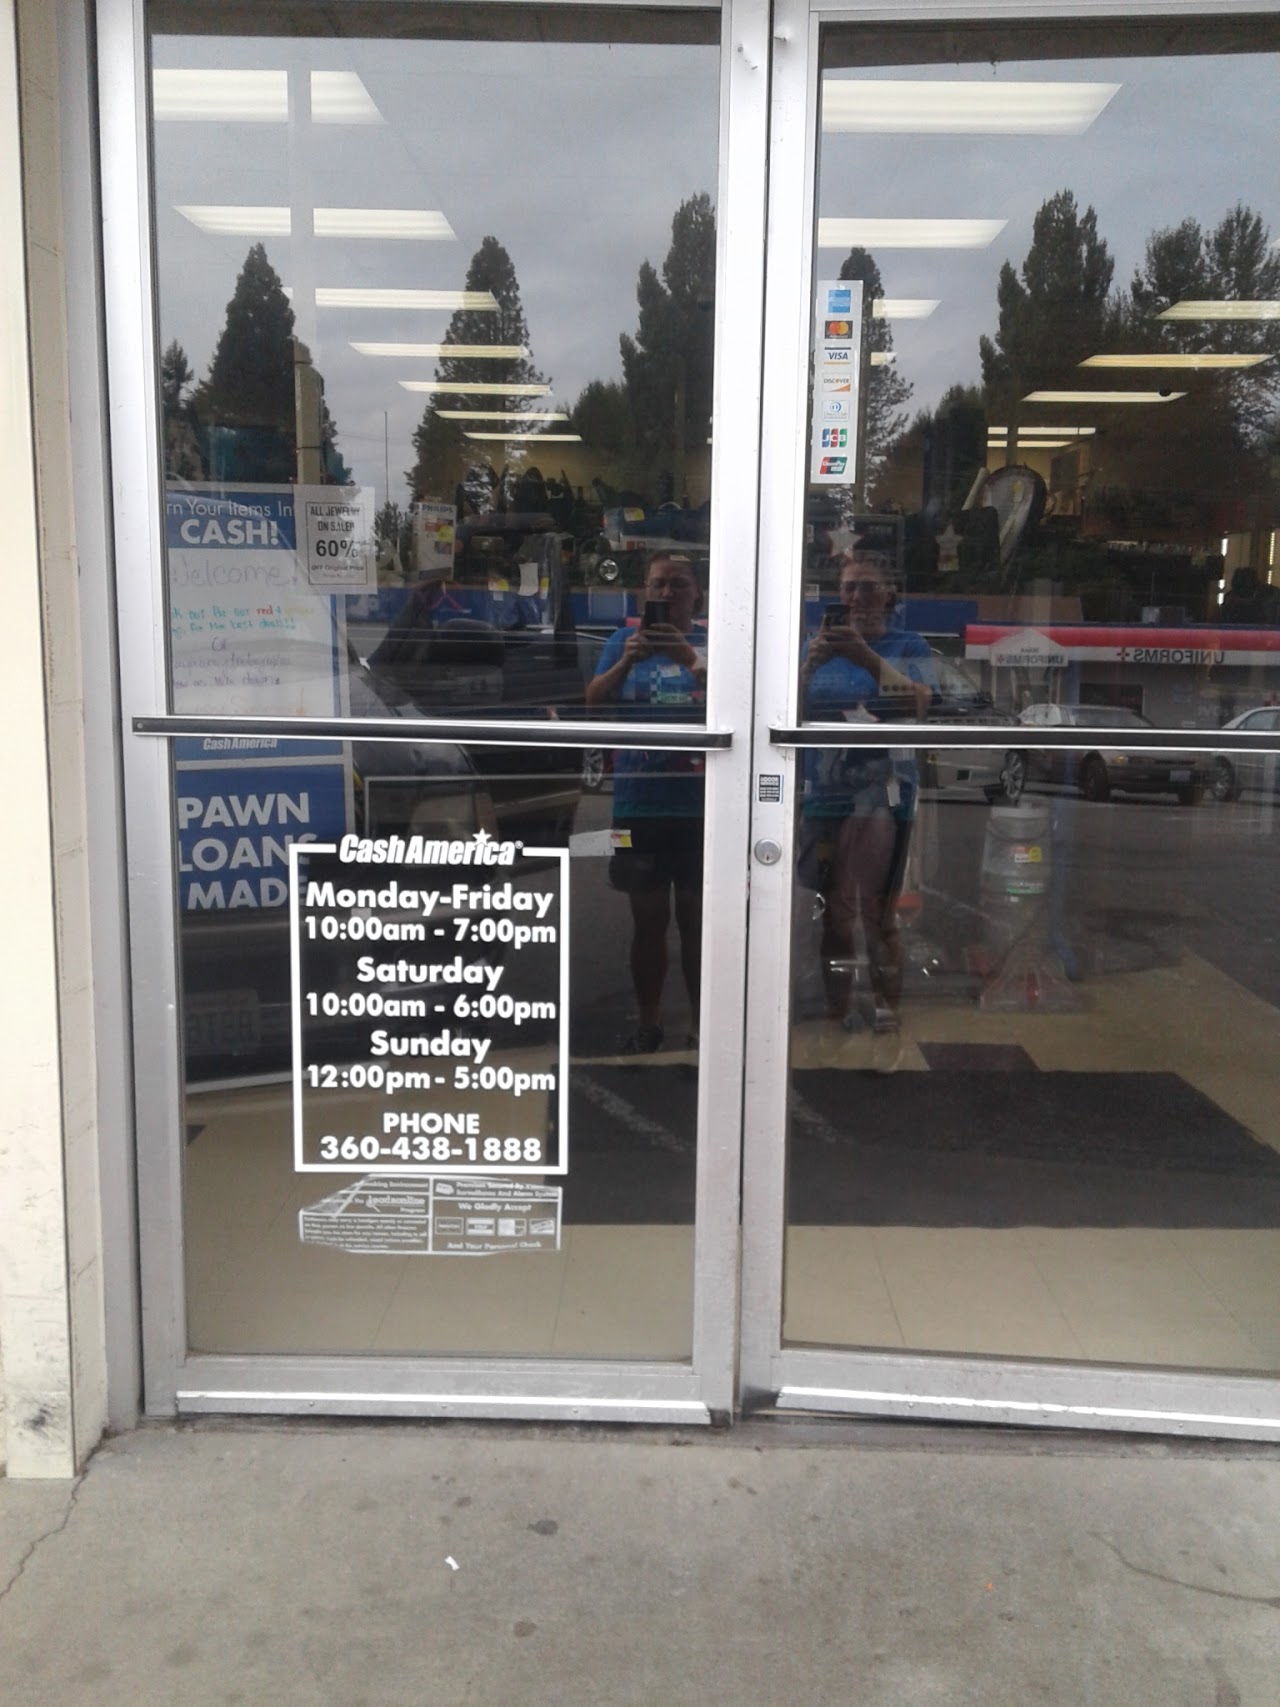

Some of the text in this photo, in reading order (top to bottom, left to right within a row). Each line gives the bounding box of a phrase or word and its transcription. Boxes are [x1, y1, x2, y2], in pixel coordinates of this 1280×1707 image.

[828, 352, 849, 361] VISA
[187, 500, 223, 516] Your
[228, 501, 271, 516] Items
[310, 506, 324, 516] ALL
[180, 519, 280, 546] CASH!
[318, 521, 329, 532] ON
[316, 540, 359, 559] 60%
[256, 604, 274, 616] red
[177, 792, 310, 829] PAWN
[305, 881, 554, 918] Monday-Friday
[305, 916, 556, 949] 10:00am - 7:00pm
[357, 956, 504, 991] Saturday
[306, 992, 556, 1025] 10:00am - 6:00pm
[370, 1029, 492, 1064] Sunday
[307, 1064, 430, 1094] 12:00pm
[454, 1066, 556, 1096] 5:00pm
[383, 1112, 480, 1134] PHONE
[320, 1136, 542, 1161] 360-438-1888
[474, 1202, 502, 1212] Gladly
[504, 1203, 532, 1212] Accept
[447, 1241, 464, 1249] And
